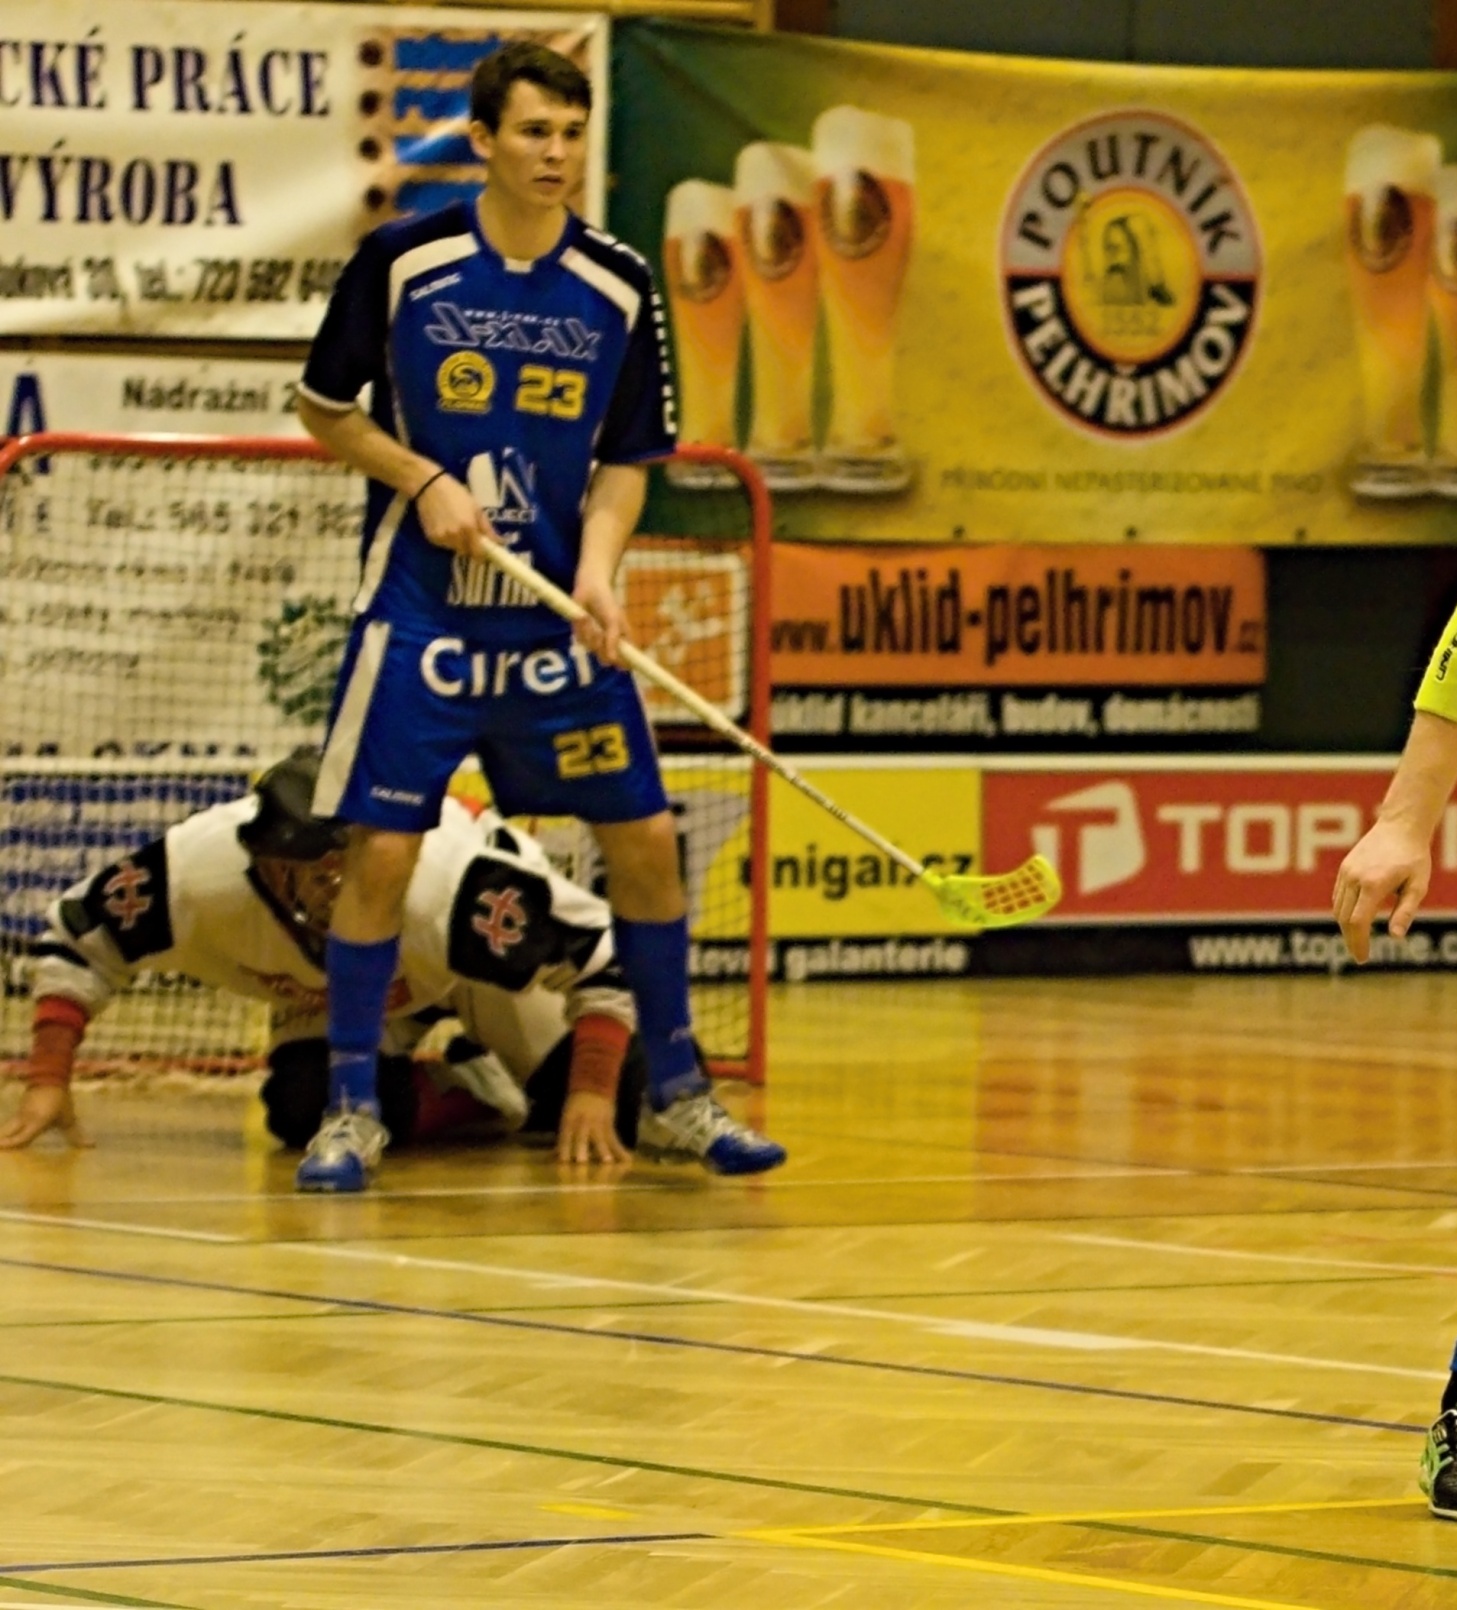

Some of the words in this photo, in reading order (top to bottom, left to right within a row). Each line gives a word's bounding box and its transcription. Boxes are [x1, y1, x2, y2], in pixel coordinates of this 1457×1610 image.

[130, 30, 331, 117] PRÁCE
[0, 137, 243, 226] VÝROBA
[513, 363, 588, 422] 23
[1012, 281, 1251, 428] PELHŘIMOV
[553, 722, 630, 780] 23
